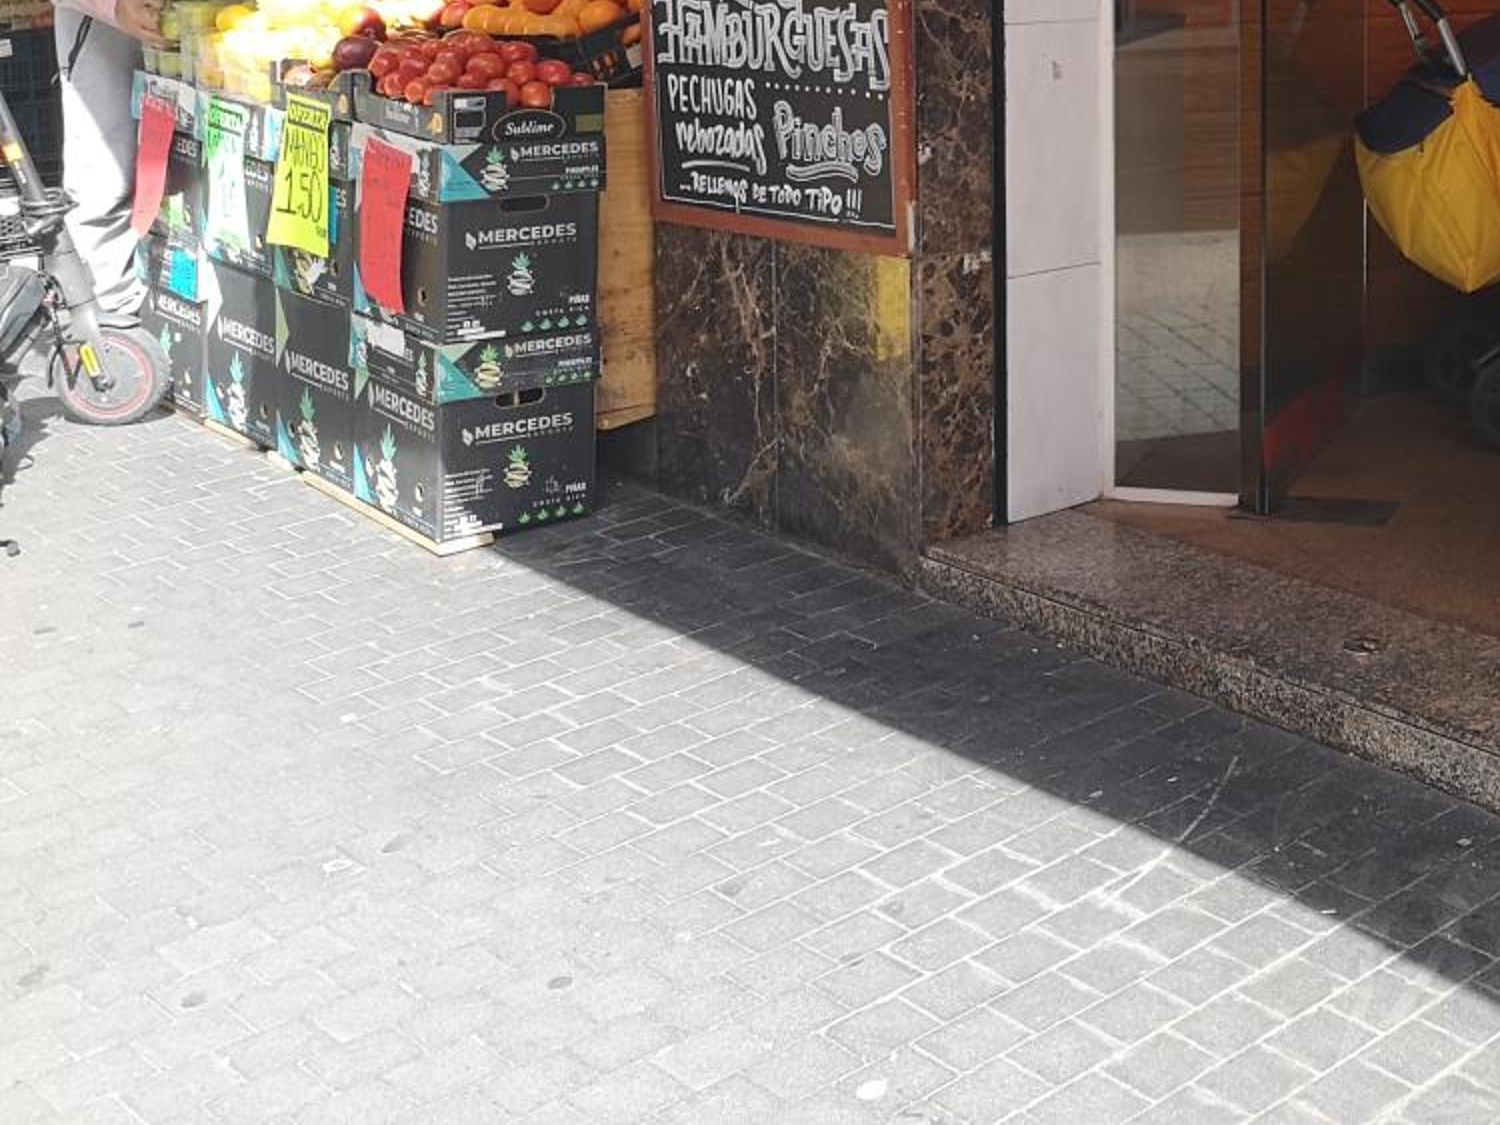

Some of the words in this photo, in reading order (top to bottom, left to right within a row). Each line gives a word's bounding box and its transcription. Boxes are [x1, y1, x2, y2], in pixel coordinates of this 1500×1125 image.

[667, 74, 757, 120] PECHUGAS
[504, 121, 554, 137] Sublime
[675, 118, 767, 175] rebozadas
[773, 100, 886, 175] Pinchos
[521, 141, 598, 157] MERCEDES
[478, 222, 577, 244] MERCEDES
[224, 316, 275, 353] MERCEDES
[515, 332, 592, 353] MERCEDES
[291, 351, 349, 391] MERCEDES
[375, 382, 436, 432] MERCEDES
[475, 413, 573, 439] MERCEDES
